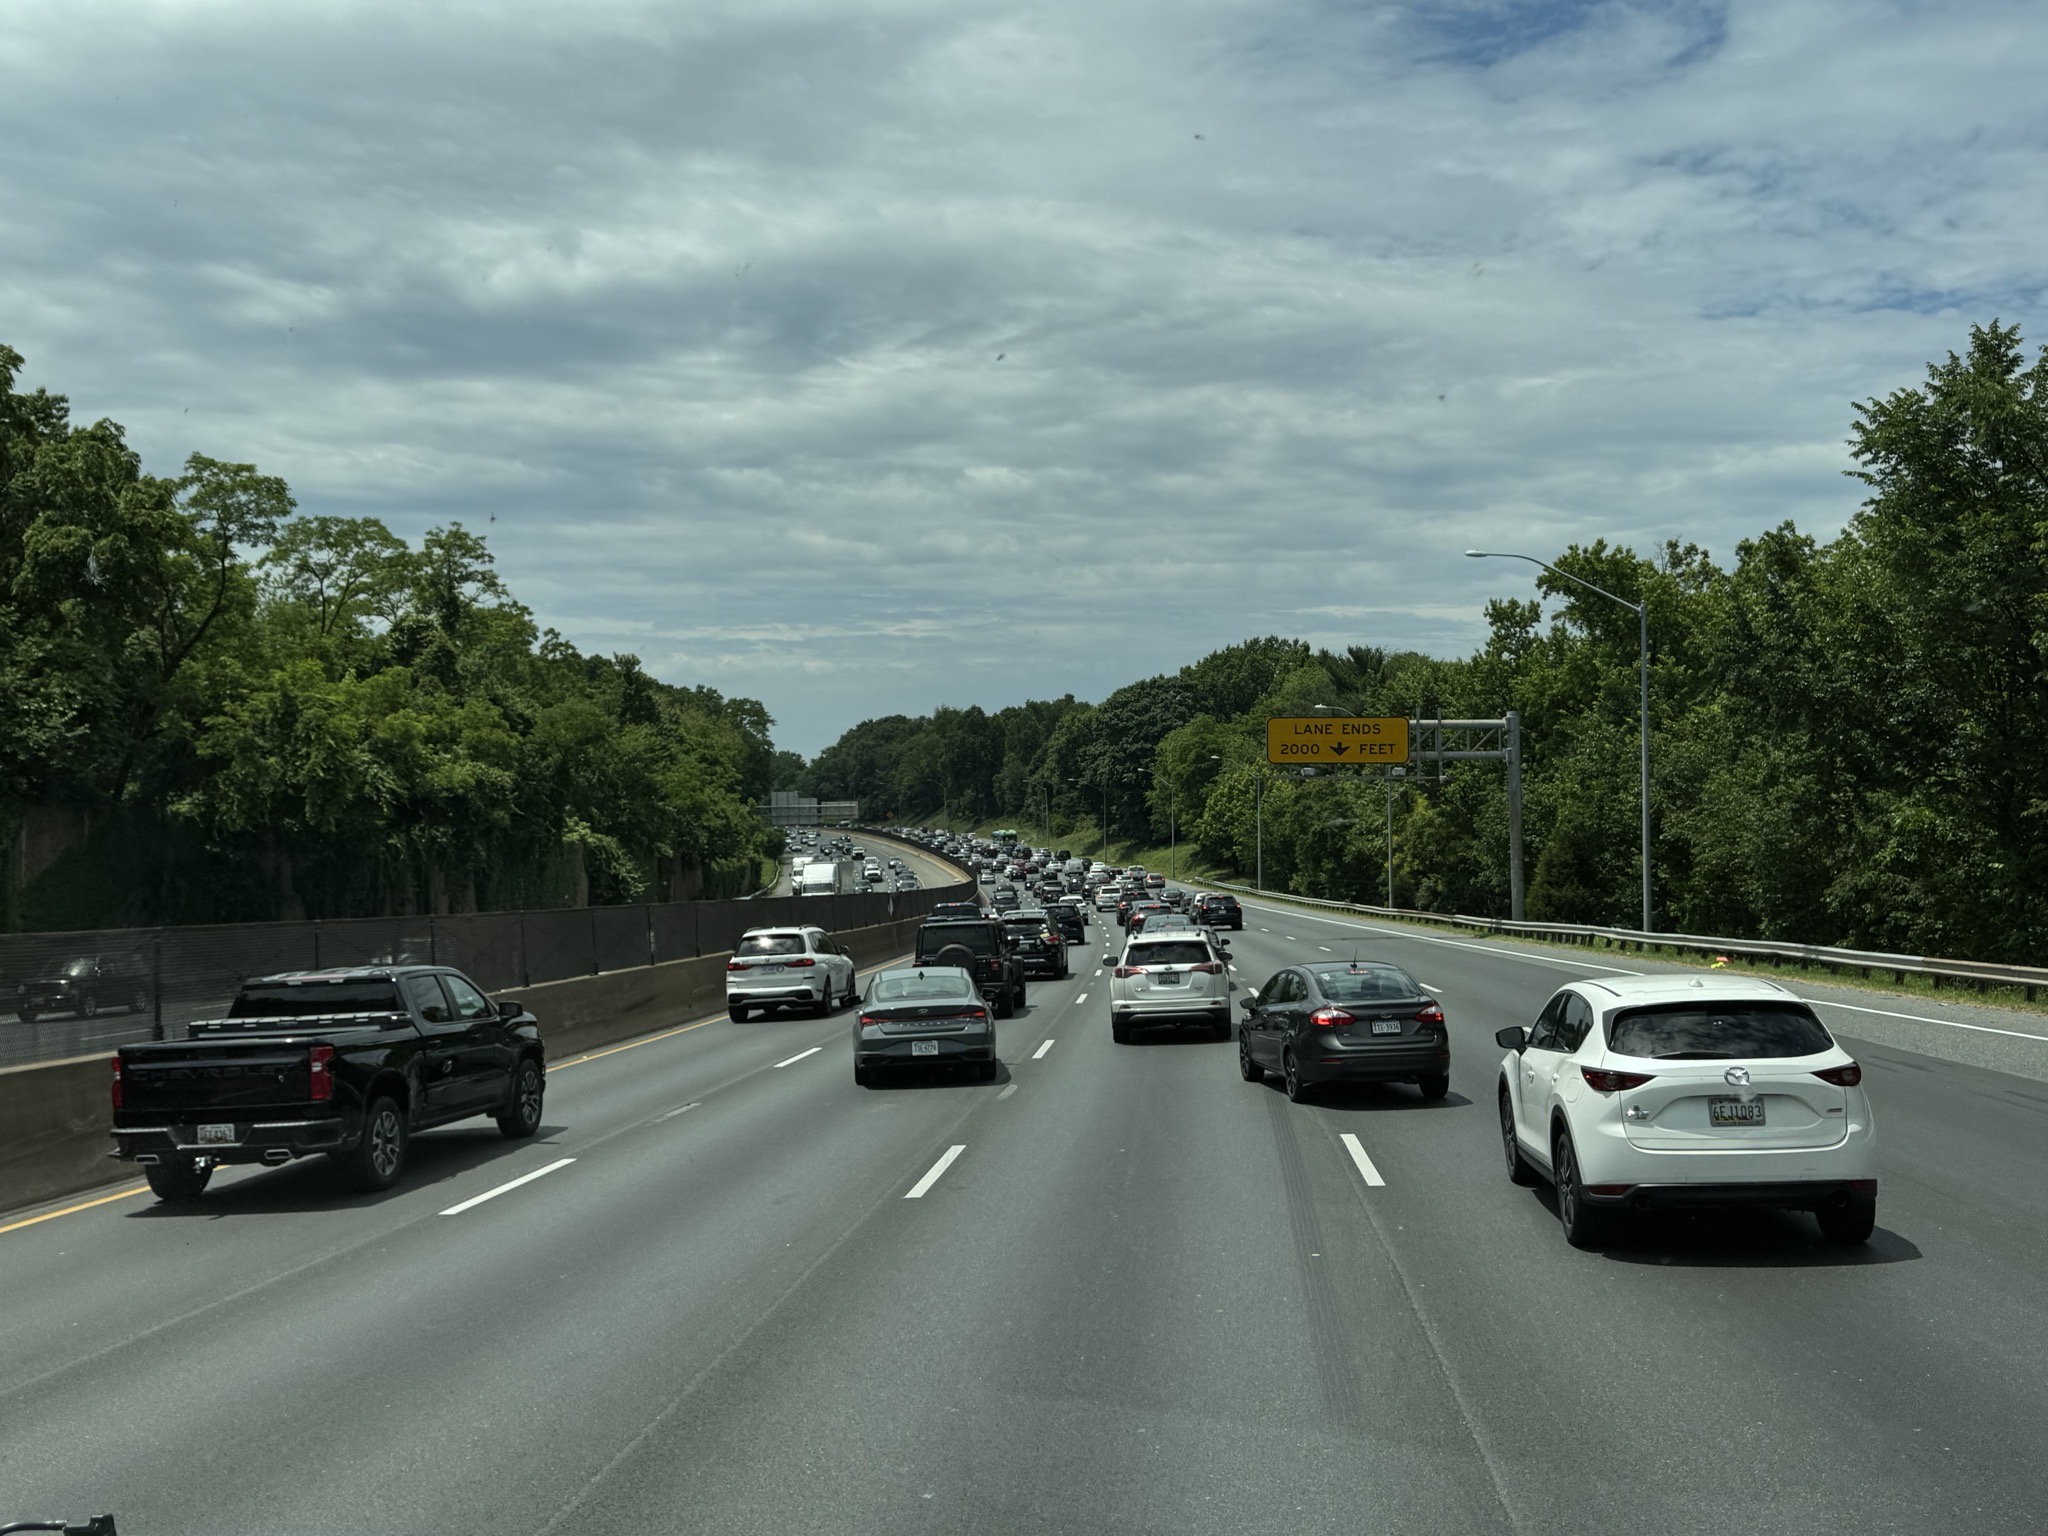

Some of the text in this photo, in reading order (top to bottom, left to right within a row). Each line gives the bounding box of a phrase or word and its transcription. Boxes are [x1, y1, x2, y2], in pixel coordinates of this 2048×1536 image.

[1294, 723, 1381, 735] LANE ENDS
[1280, 743, 1396, 755] 2000 FEET
